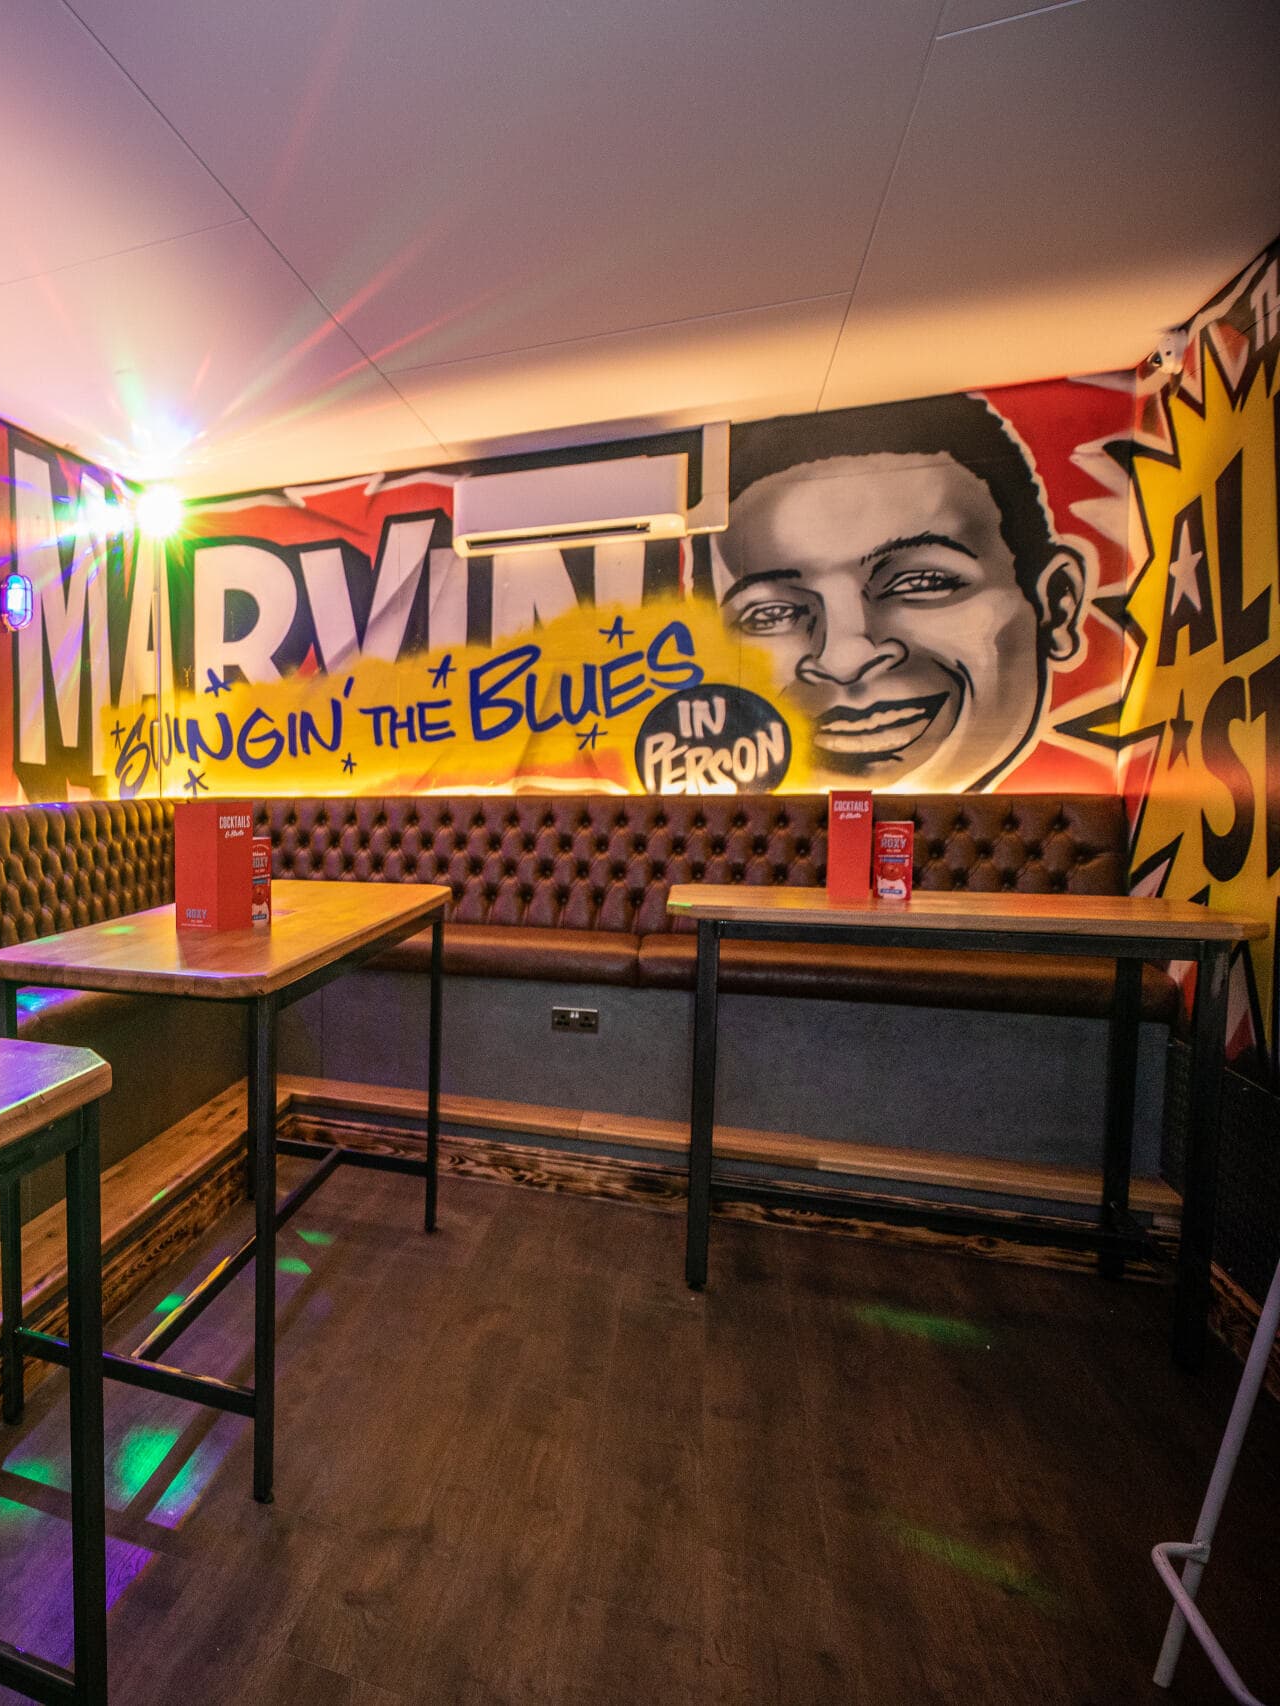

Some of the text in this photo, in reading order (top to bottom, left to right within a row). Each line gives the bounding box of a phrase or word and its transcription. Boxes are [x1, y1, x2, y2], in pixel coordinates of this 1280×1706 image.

[358, 699, 456, 748] THE
[468, 620, 705, 743] BLUES
[677, 695, 728, 740] IN
[642, 722, 786, 796] PERSON
[219, 815, 251, 829] COCKTAILS
